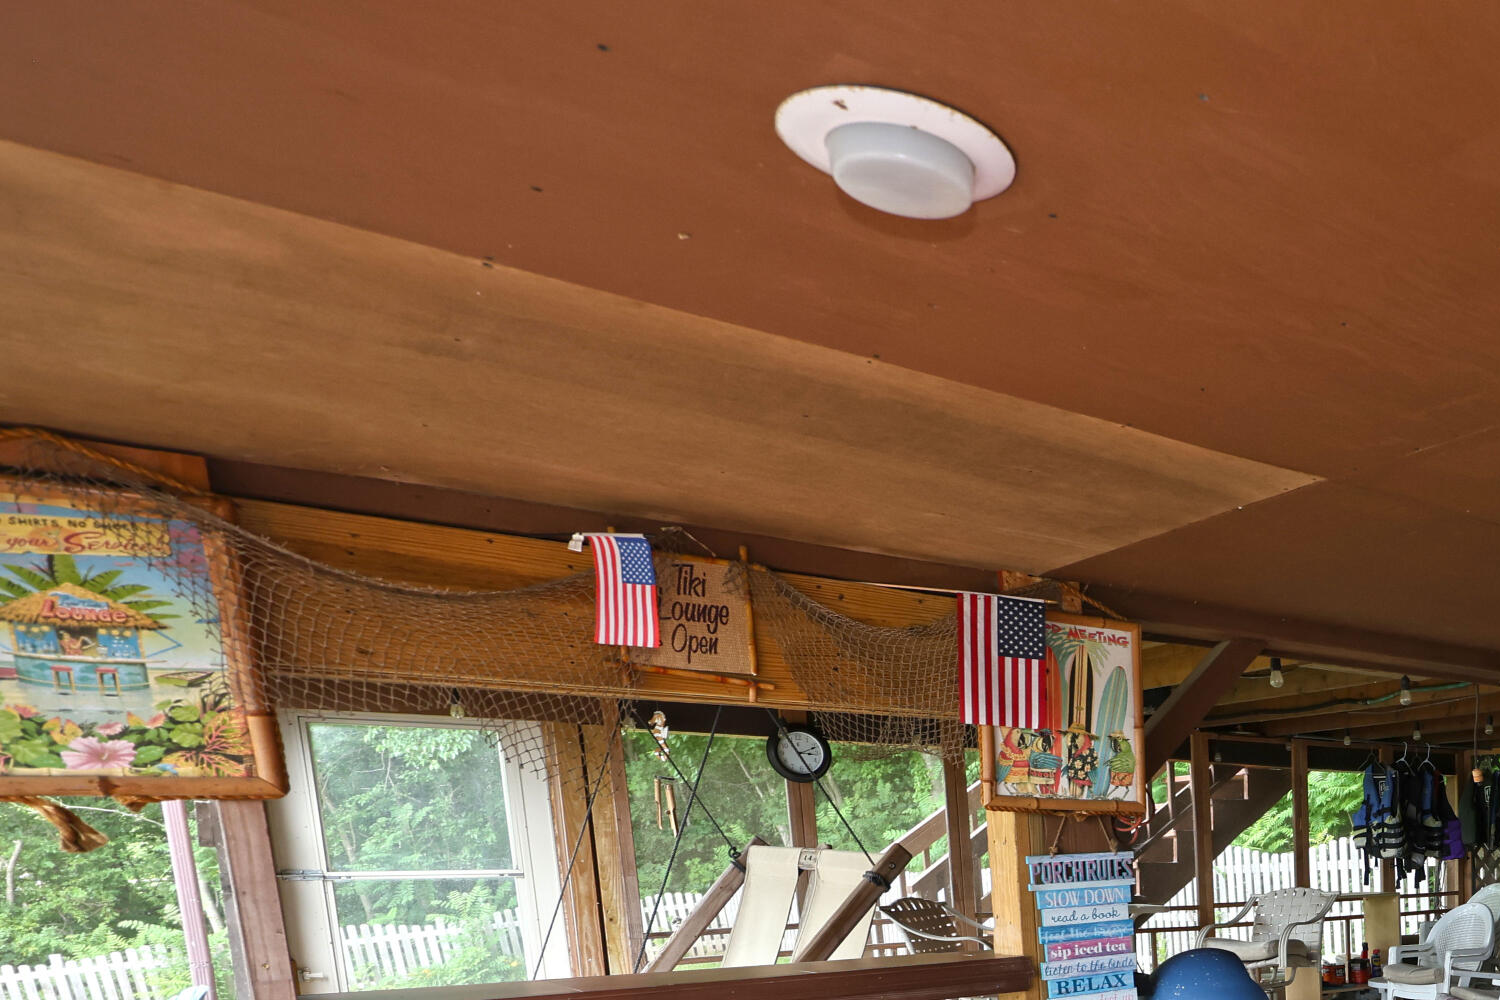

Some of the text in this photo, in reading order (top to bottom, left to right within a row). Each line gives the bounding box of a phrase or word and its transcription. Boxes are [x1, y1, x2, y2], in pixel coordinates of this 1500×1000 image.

[672, 563, 707, 597] Tiki
[659, 587, 730, 634] Lounge
[671, 624, 719, 664] Open
[1067, 627, 1129, 647] MEETING
[1032, 858, 1134, 885] PORCH RULES
[1045, 888, 1124, 907] SLOW DOWN
[1051, 907, 1120, 923] read a book
[1050, 941, 1127, 960] sip iced tea
[1045, 962, 1073, 976] listen
[1077, 963, 1087, 972] to
[1090, 960, 1105, 970] the
[1056, 973, 1127, 995] RELAX
